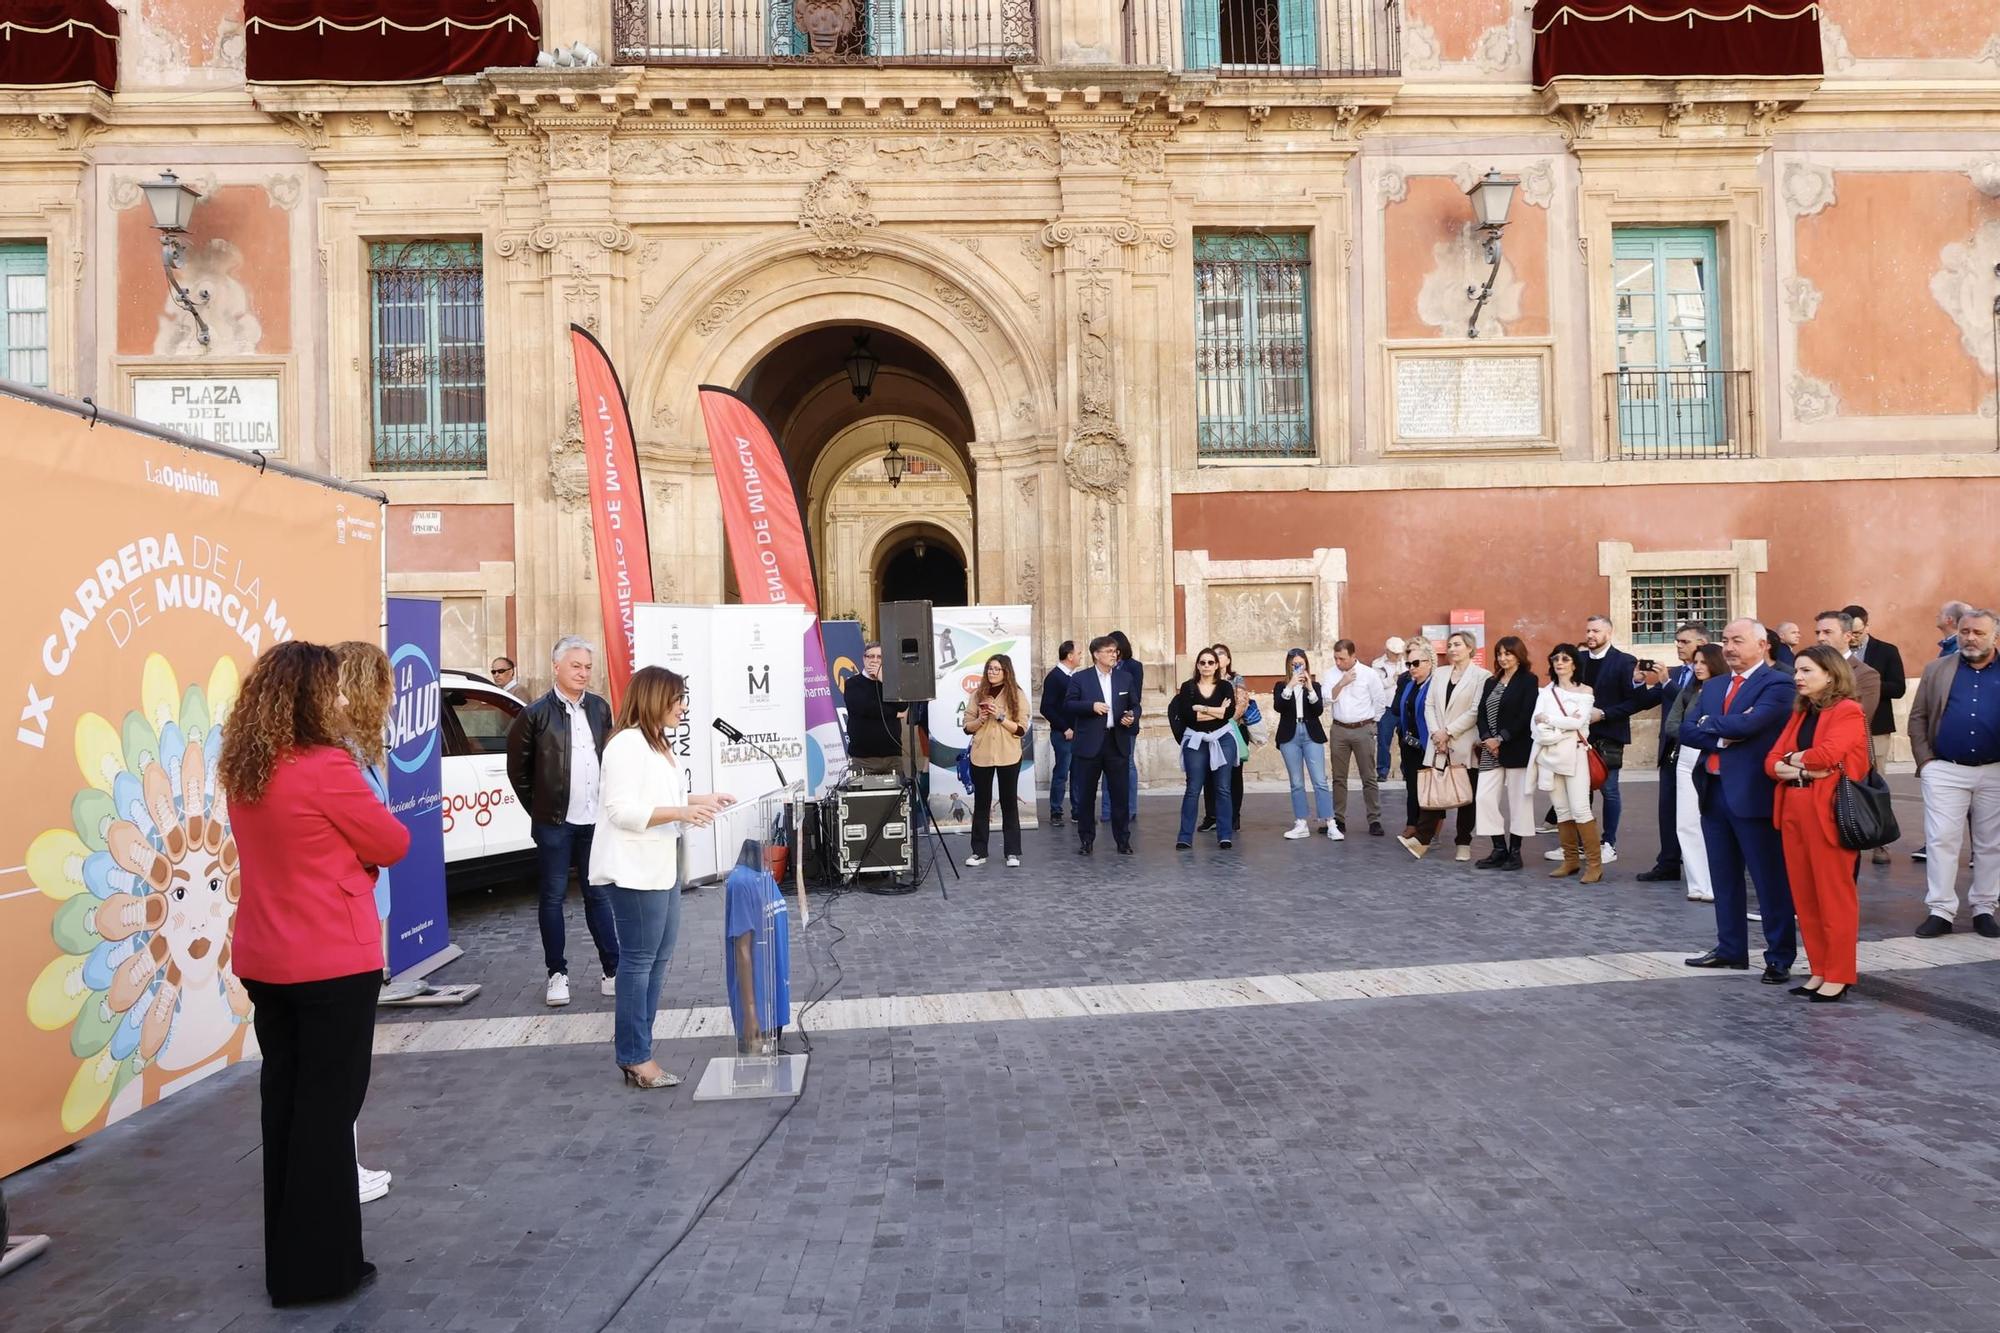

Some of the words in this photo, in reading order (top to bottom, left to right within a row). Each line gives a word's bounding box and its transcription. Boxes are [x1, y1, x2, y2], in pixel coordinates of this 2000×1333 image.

[171, 386, 241, 405] PLAZA
[188, 407, 226, 419] DEL
[144, 460, 220, 496] LaOpinión
[105, 586, 152, 649] DE
[155, 573, 262, 658] MURCIA
[16, 682, 55, 749] IX
[42, 533, 185, 677] CARRERA
[193, 535, 230, 580] DE
[233, 559, 261, 610] LA
[401, 664, 413, 692] LA
